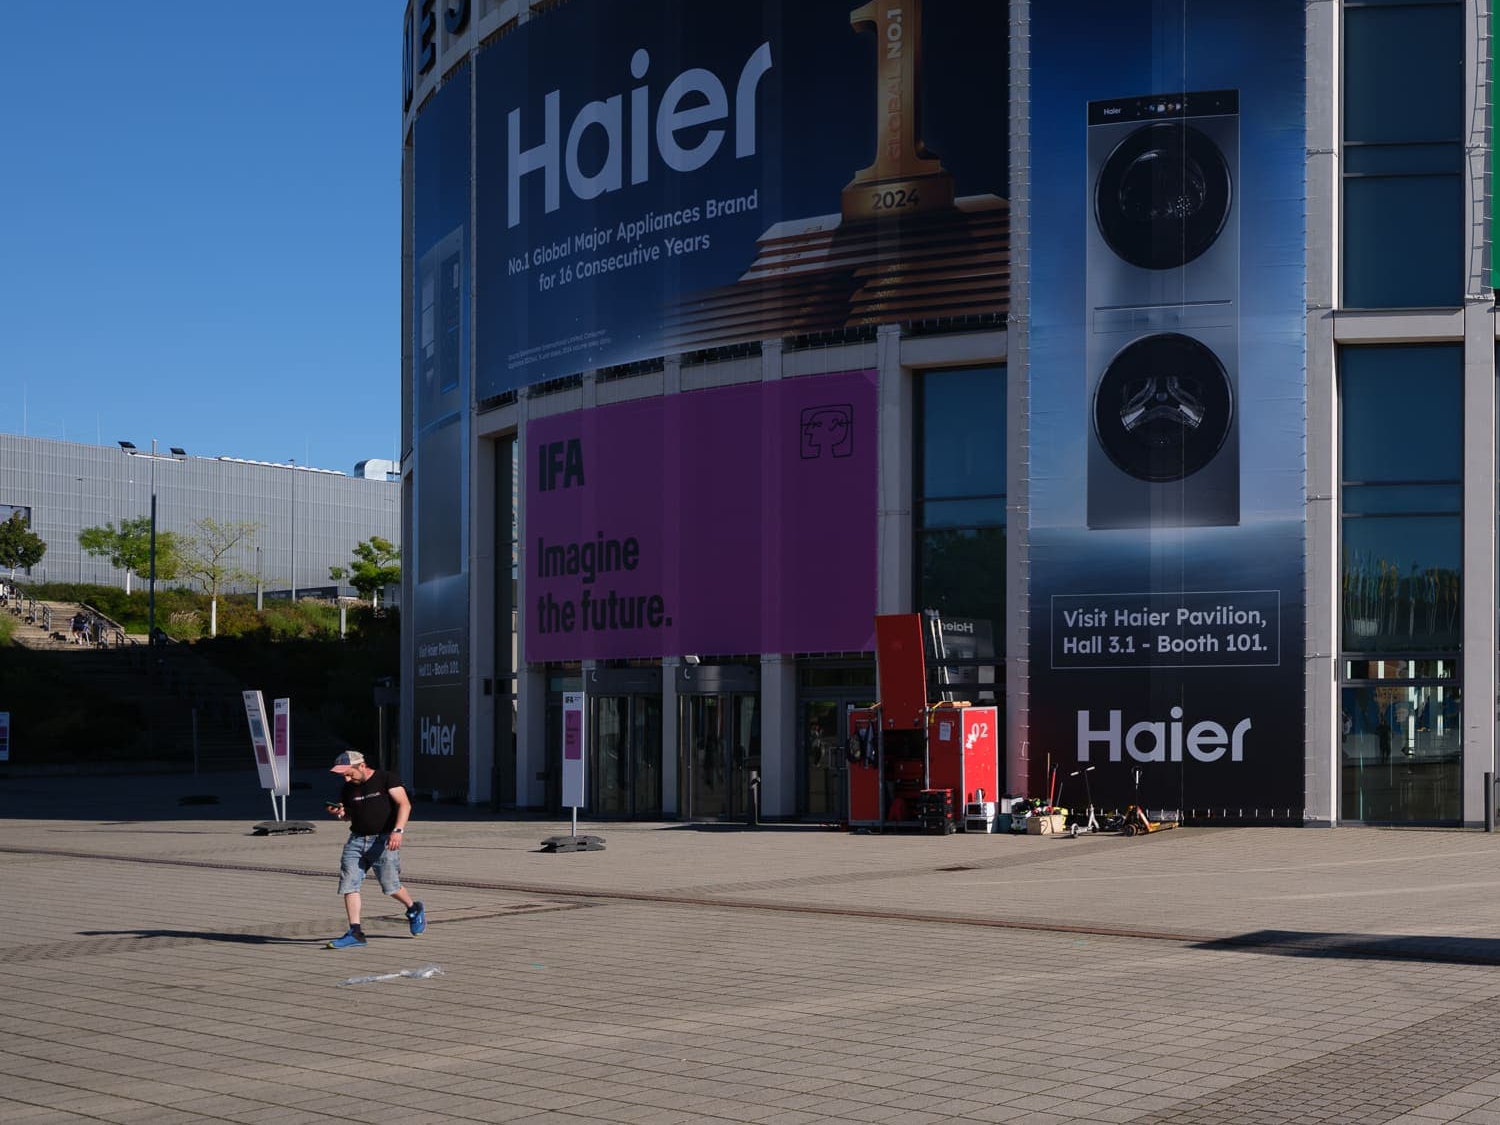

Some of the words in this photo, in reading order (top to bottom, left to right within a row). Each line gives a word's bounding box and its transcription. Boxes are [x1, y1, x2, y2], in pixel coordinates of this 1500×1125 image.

[887, 8, 904, 60] NO.1
[508, 41, 773, 229] Haier
[1103, 107, 1121, 115] Haier
[871, 188, 920, 210] 2024
[508, 252, 530, 276] No.1
[533, 238, 572, 267] Global
[574, 227, 613, 253] Major
[616, 206, 700, 244] Appliances
[706, 189, 758, 220] Brand
[538, 272, 555, 292] for
[559, 265, 573, 285] 16
[575, 242, 660, 280] Consecutive
[664, 233, 711, 258] Years
[538, 437, 585, 492] IFA
[538, 531, 639, 584] Imagine
[537, 594, 576, 634] the
[581, 588, 673, 631] future.
[1063, 607, 1108, 628] Visit
[1114, 606, 1169, 627] Haier
[1176, 605, 1267, 631] Pavilion,
[1063, 632, 1102, 654] Hall
[1108, 633, 1136, 654] 3.1
[1157, 632, 1218, 653] Booth
[1225, 631, 1268, 653] 101.
[420, 715, 456, 756] Haier
[1077, 706, 1252, 762] Haier
